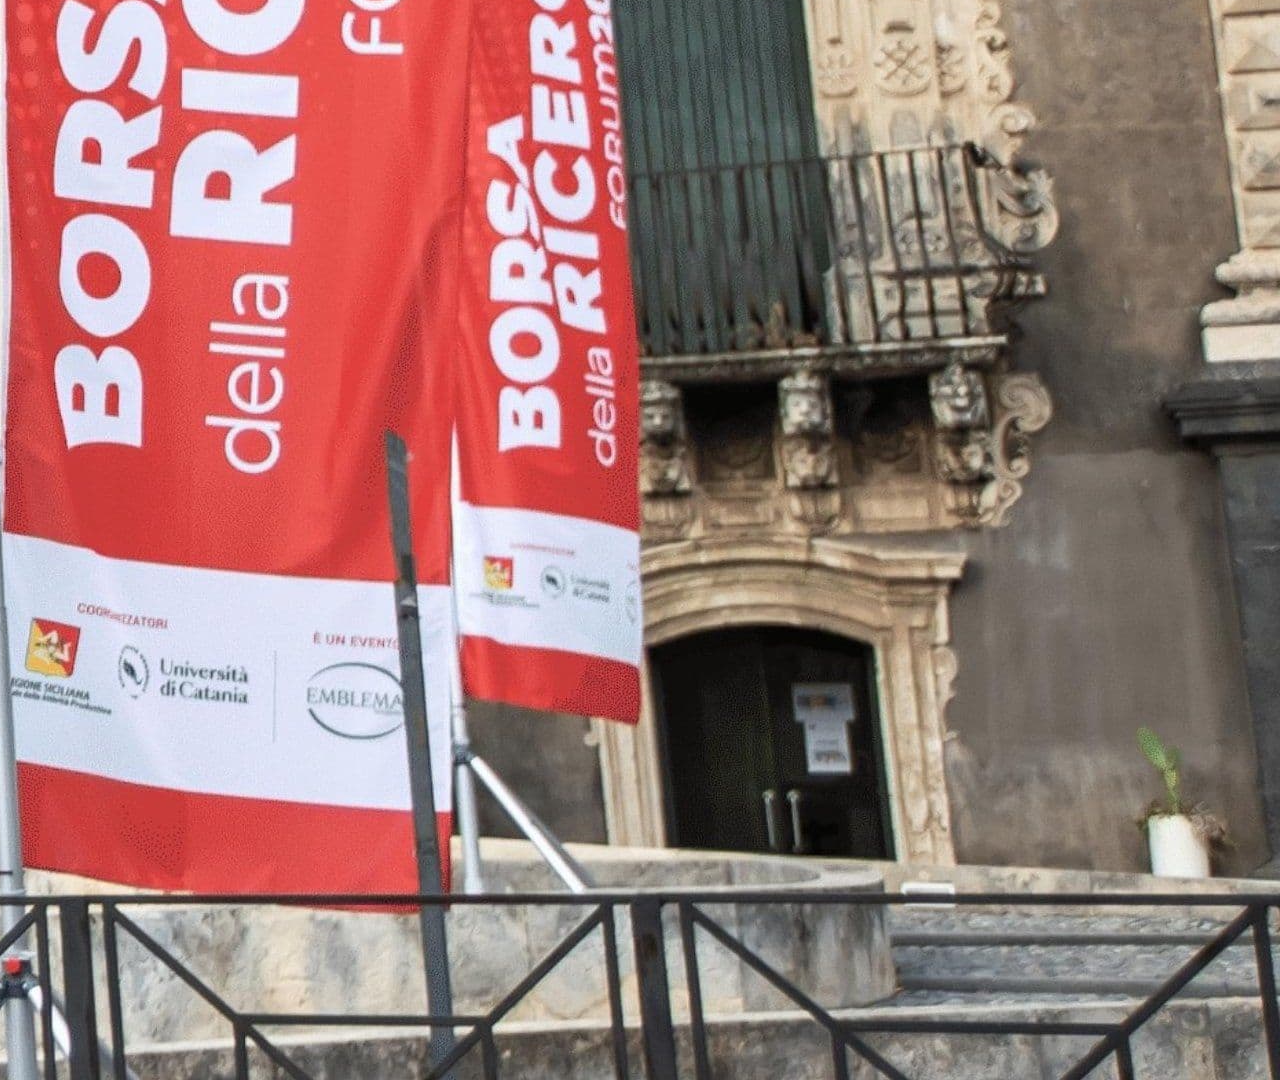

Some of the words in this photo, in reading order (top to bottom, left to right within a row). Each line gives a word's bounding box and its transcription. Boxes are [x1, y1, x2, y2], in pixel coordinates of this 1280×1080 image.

[486, 114, 562, 453] BORSA
[205, 271, 290, 475] della
[585, 347, 617, 468] della
[159, 658, 249, 683] Università
[159, 679, 175, 697] di
[178, 683, 249, 704] Catania
